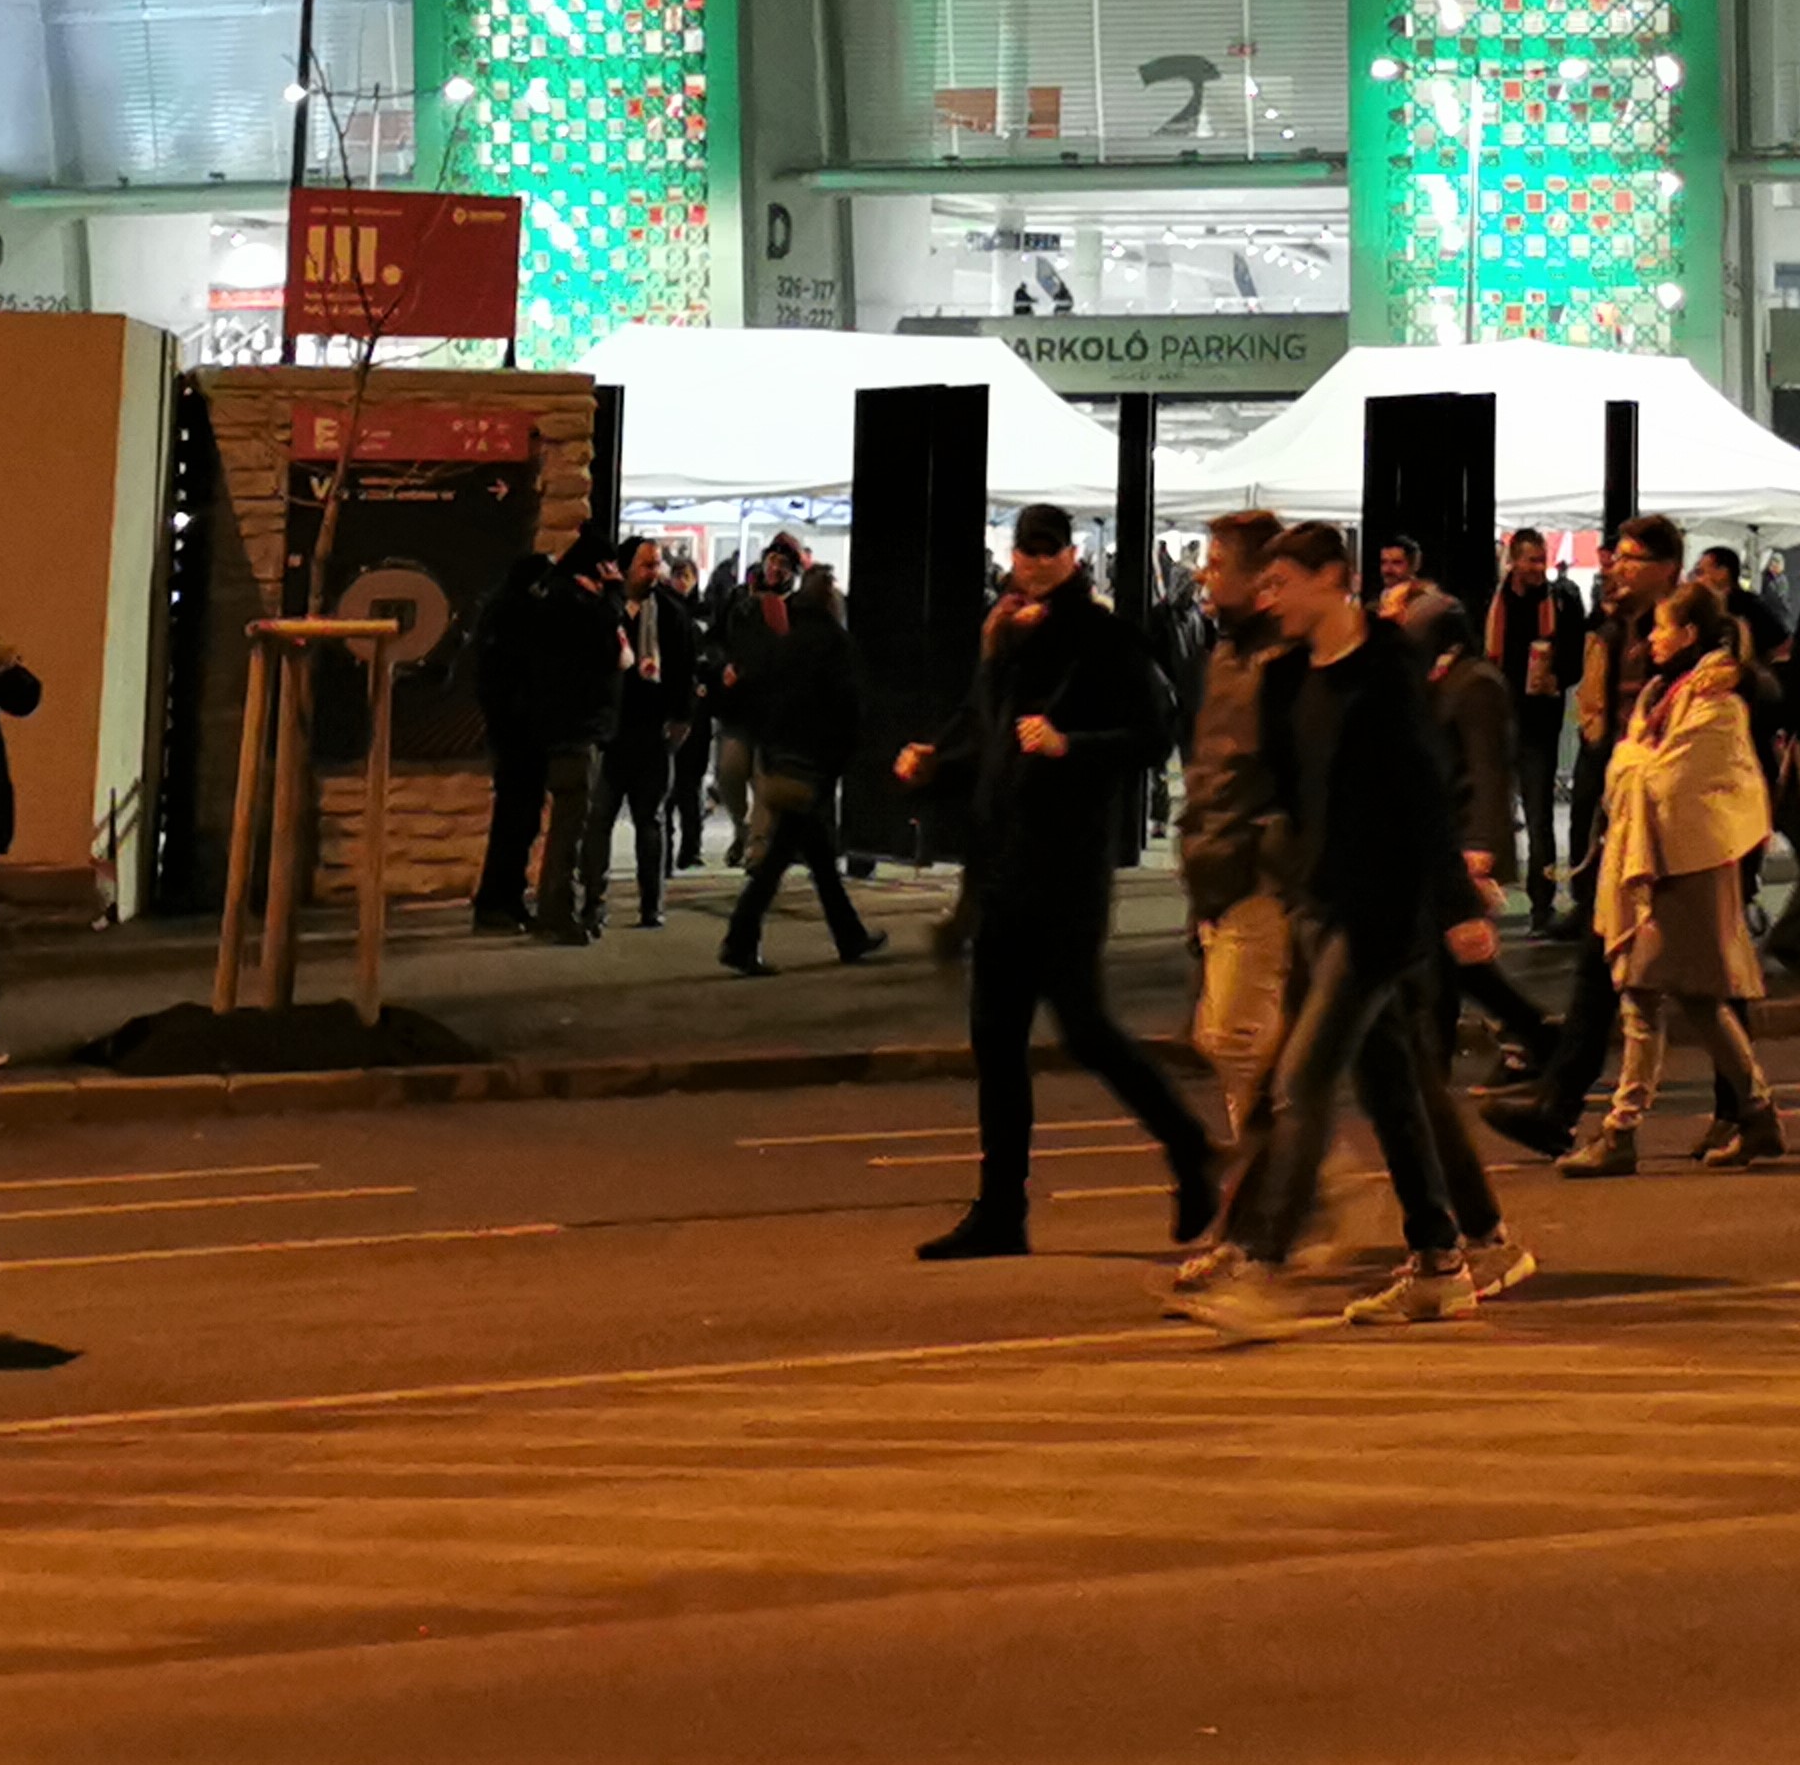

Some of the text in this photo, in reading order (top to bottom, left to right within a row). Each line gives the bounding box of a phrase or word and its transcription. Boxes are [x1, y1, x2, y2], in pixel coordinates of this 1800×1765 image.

[304, 225, 402, 286] III.
[767, 202, 792, 260] D
[1002, 329, 1307, 362] ARKOLÓ PARKING
